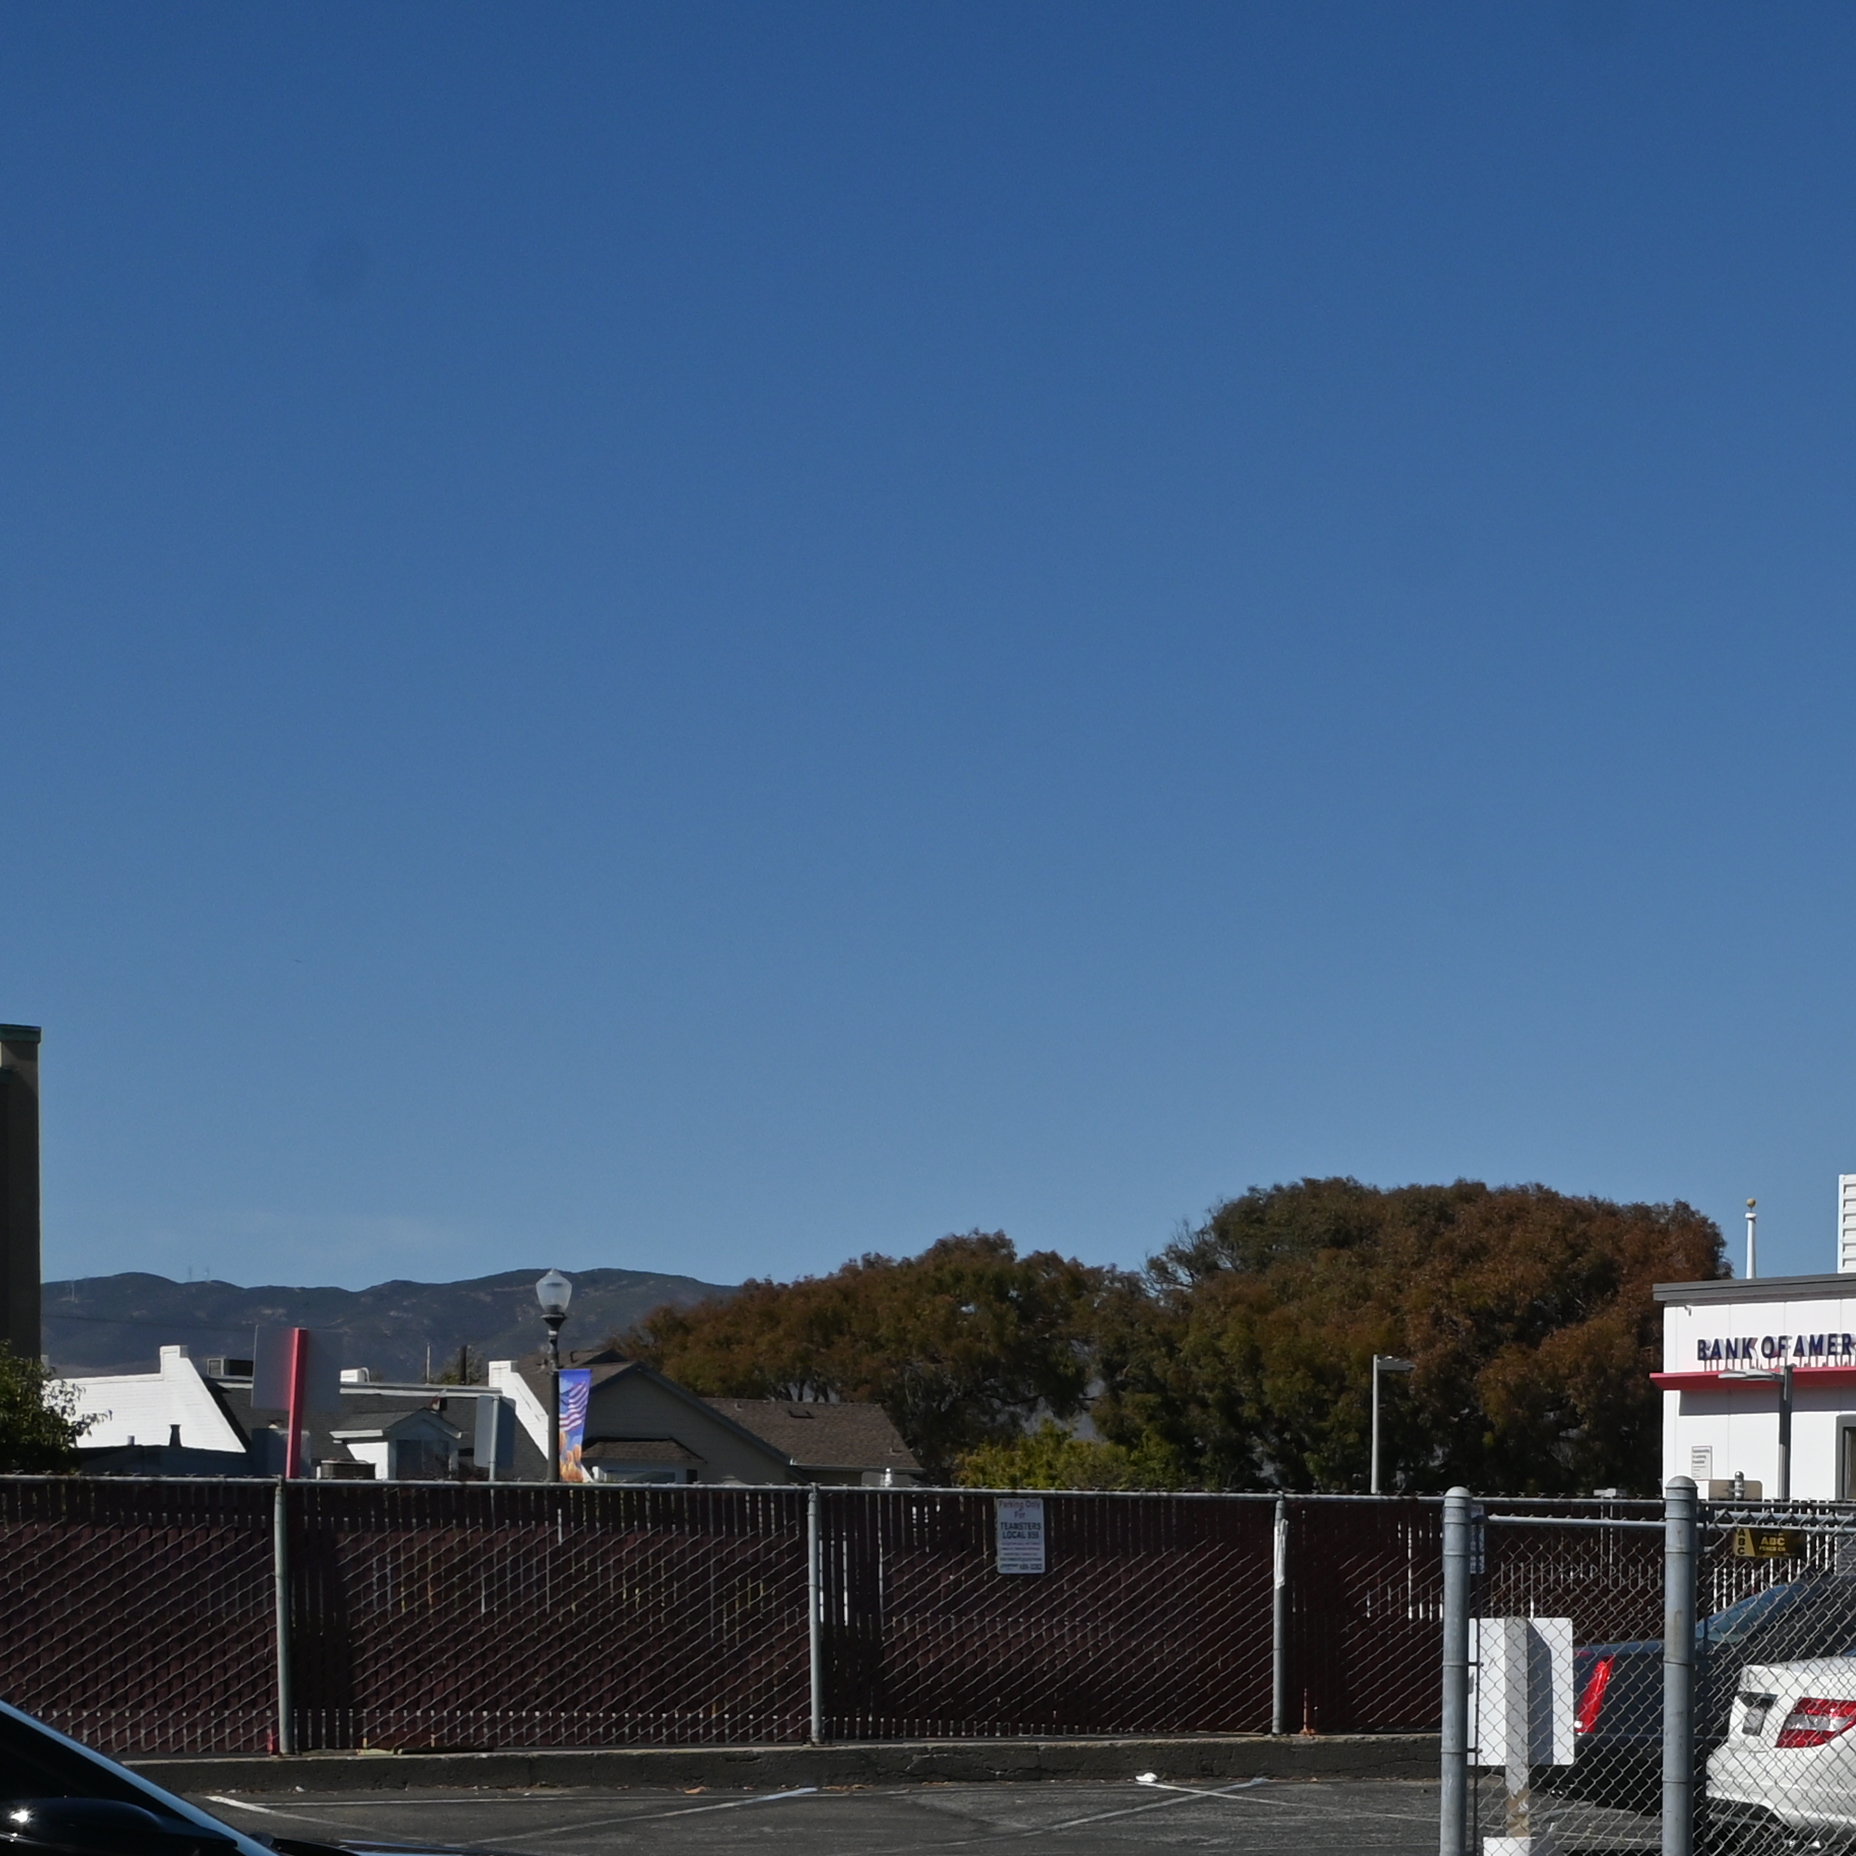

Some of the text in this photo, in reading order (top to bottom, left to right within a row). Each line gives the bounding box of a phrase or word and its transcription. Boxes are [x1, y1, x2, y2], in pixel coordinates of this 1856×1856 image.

[1697, 1338, 1757, 1361] BANK
[1761, 1335, 1792, 1359] OF
[1761, 1536, 1785, 1546] ABC
